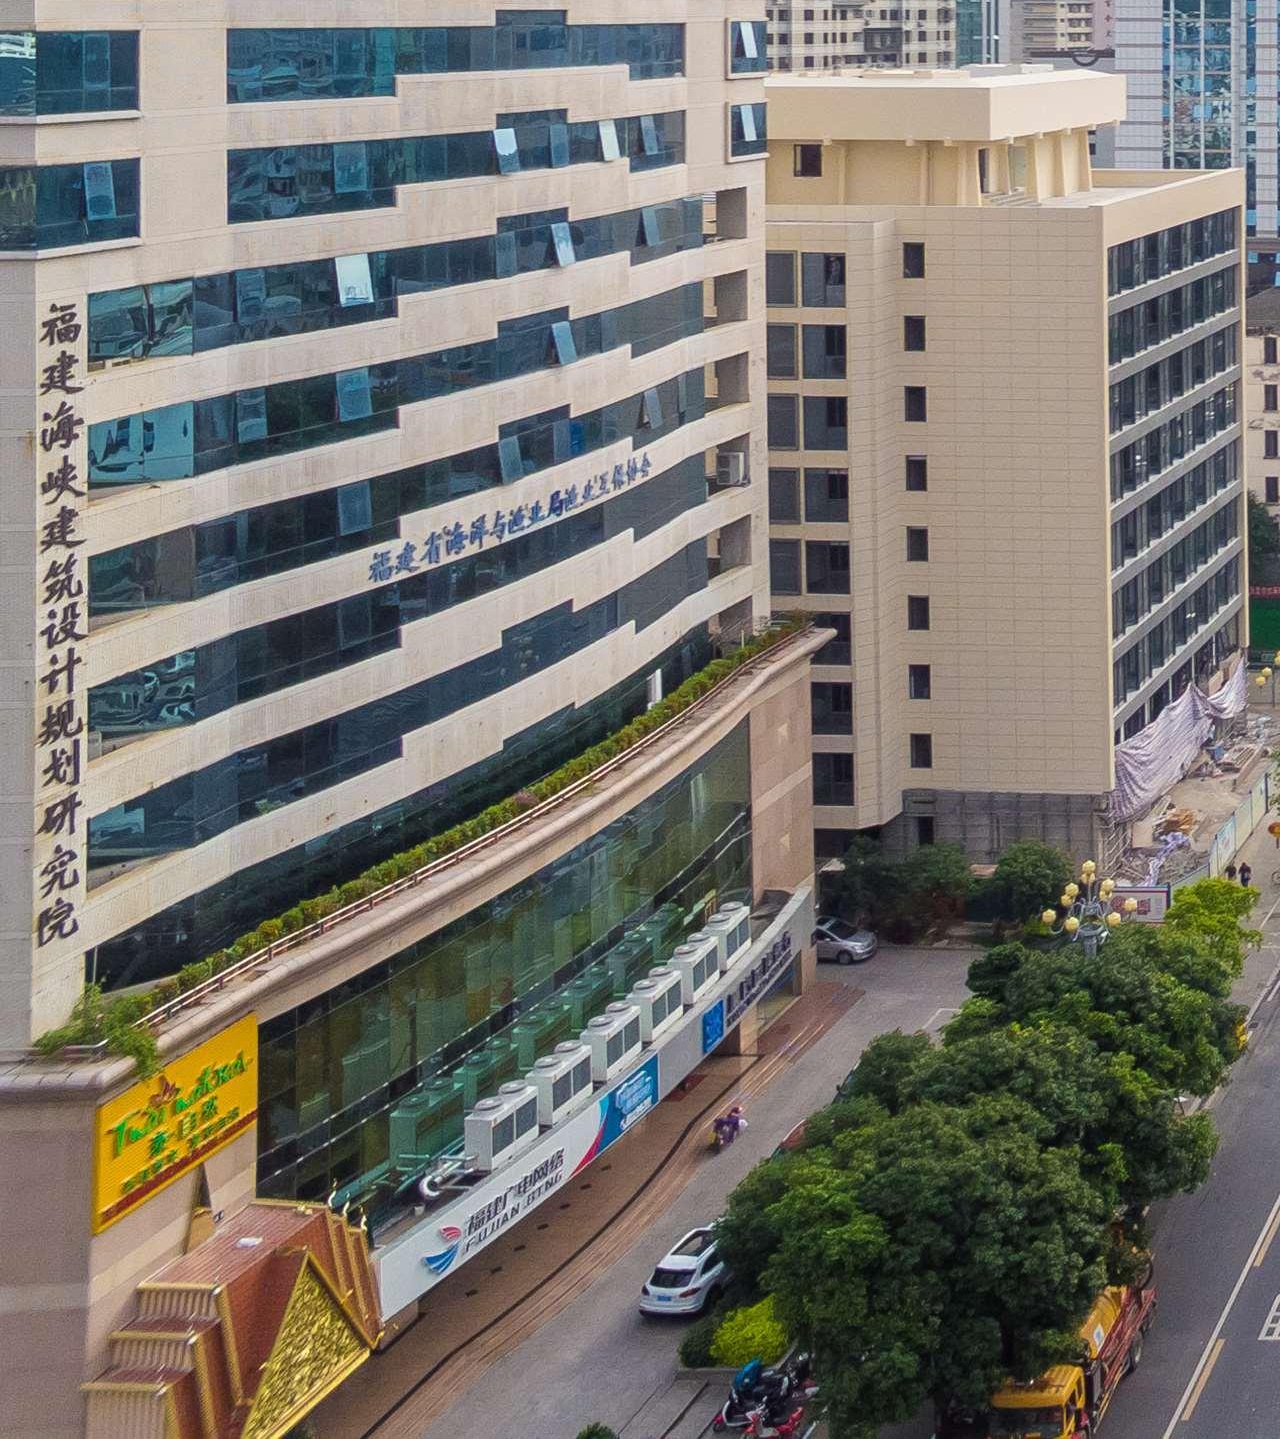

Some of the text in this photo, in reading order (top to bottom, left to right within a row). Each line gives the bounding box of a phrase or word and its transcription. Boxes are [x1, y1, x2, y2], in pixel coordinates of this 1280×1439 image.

[36, 302, 87, 948] 福建海峡建筑设计规划研究院
[465, 1146, 566, 1237] 福建广电网络
[465, 1201, 520, 1253] FUJIAN
